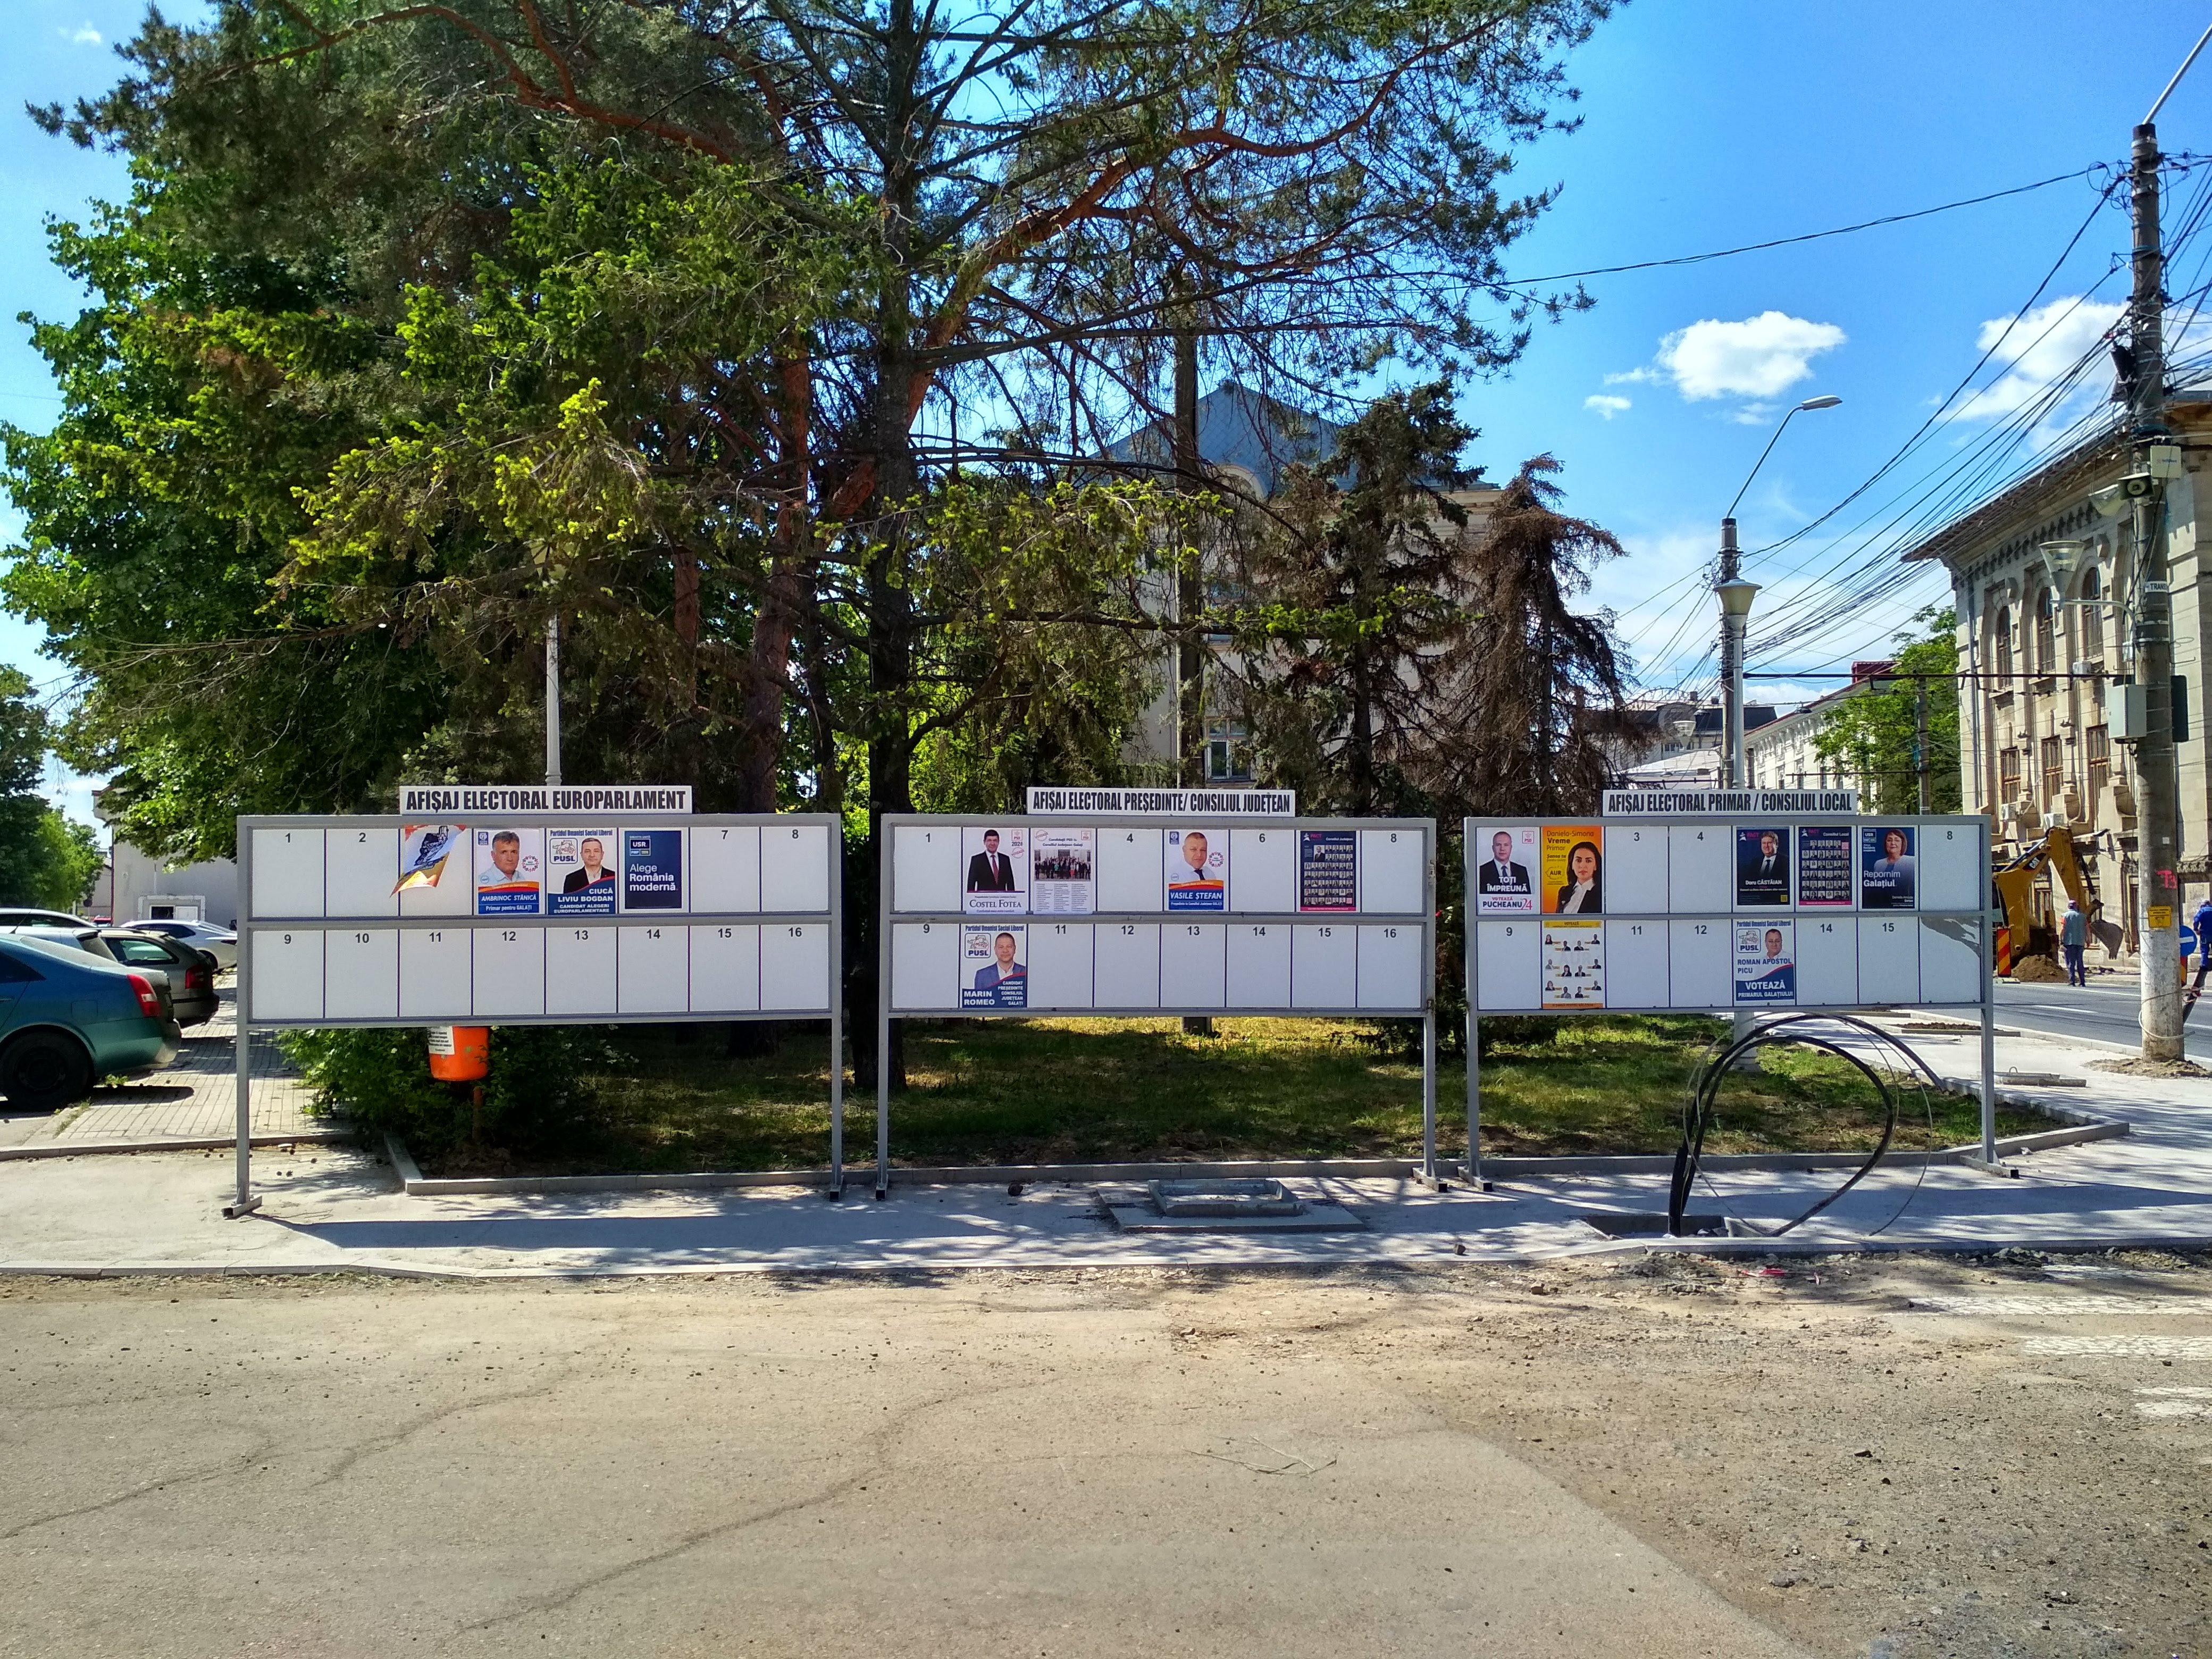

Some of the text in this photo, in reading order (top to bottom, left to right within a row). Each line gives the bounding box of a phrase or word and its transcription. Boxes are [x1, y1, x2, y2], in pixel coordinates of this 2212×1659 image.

[406, 790, 685, 813] AFIȘAJ ELECTORAL EUROPARLAMENT
[1033, 791, 1066, 812] AFIȘAJ
[1069, 792, 1122, 810] ELECTORAL
[1190, 793, 1241, 812] CONSILIUL
[1243, 794, 1290, 815] JUDEȚEAN
[1608, 794, 1644, 815] AFIȘAJ
[1647, 794, 1706, 811] ELECTORAL
[1708, 793, 1751, 811] PRIMAR
[1762, 793, 1817, 811] CONSILIUL
[1820, 793, 1851, 811] LOCAL
[285, 833, 291, 843] 1
[358, 832, 366, 843] 2
[721, 830, 728, 840] 7
[792, 829, 799, 839] 8
[925, 833, 931, 843] 1
[1126, 833, 1134, 843] 4
[1259, 833, 1266, 843] 6
[1390, 833, 1397, 843] 8
[1633, 832, 1640, 842] 3
[1697, 831, 1704, 841] 4
[1947, 831, 1953, 840] 8
[2029, 857, 2040, 869] CAT
[630, 864, 657, 874] Alege
[630, 873, 674, 882] România
[788, 927, 802, 937] 16
[923, 924, 930, 934] 9
[1055, 924, 1066, 934] 11
[1121, 925, 1134, 935] 12
[1187, 926, 1200, 936] 13
[1252, 926, 1266, 936] 14
[1318, 927, 1331, 937] 15
[1506, 927, 1513, 936] 9
[1631, 925, 1642, 935] 11
[1694, 925, 1707, 935] 12
[1820, 923, 1833, 933] 14
[1882, 923, 1895, 932] 15
[355, 933, 370, 943] 10
[429, 932, 441, 942] 11
[501, 931, 516, 941] 12
[574, 930, 589, 941] 13
[647, 929, 661, 939] 14
[718, 928, 732, 938] 15
[1384, 928, 1397, 938] 16
[284, 934, 291, 944] 9
[1745, 979, 1786, 990] VOTEAZĂ
